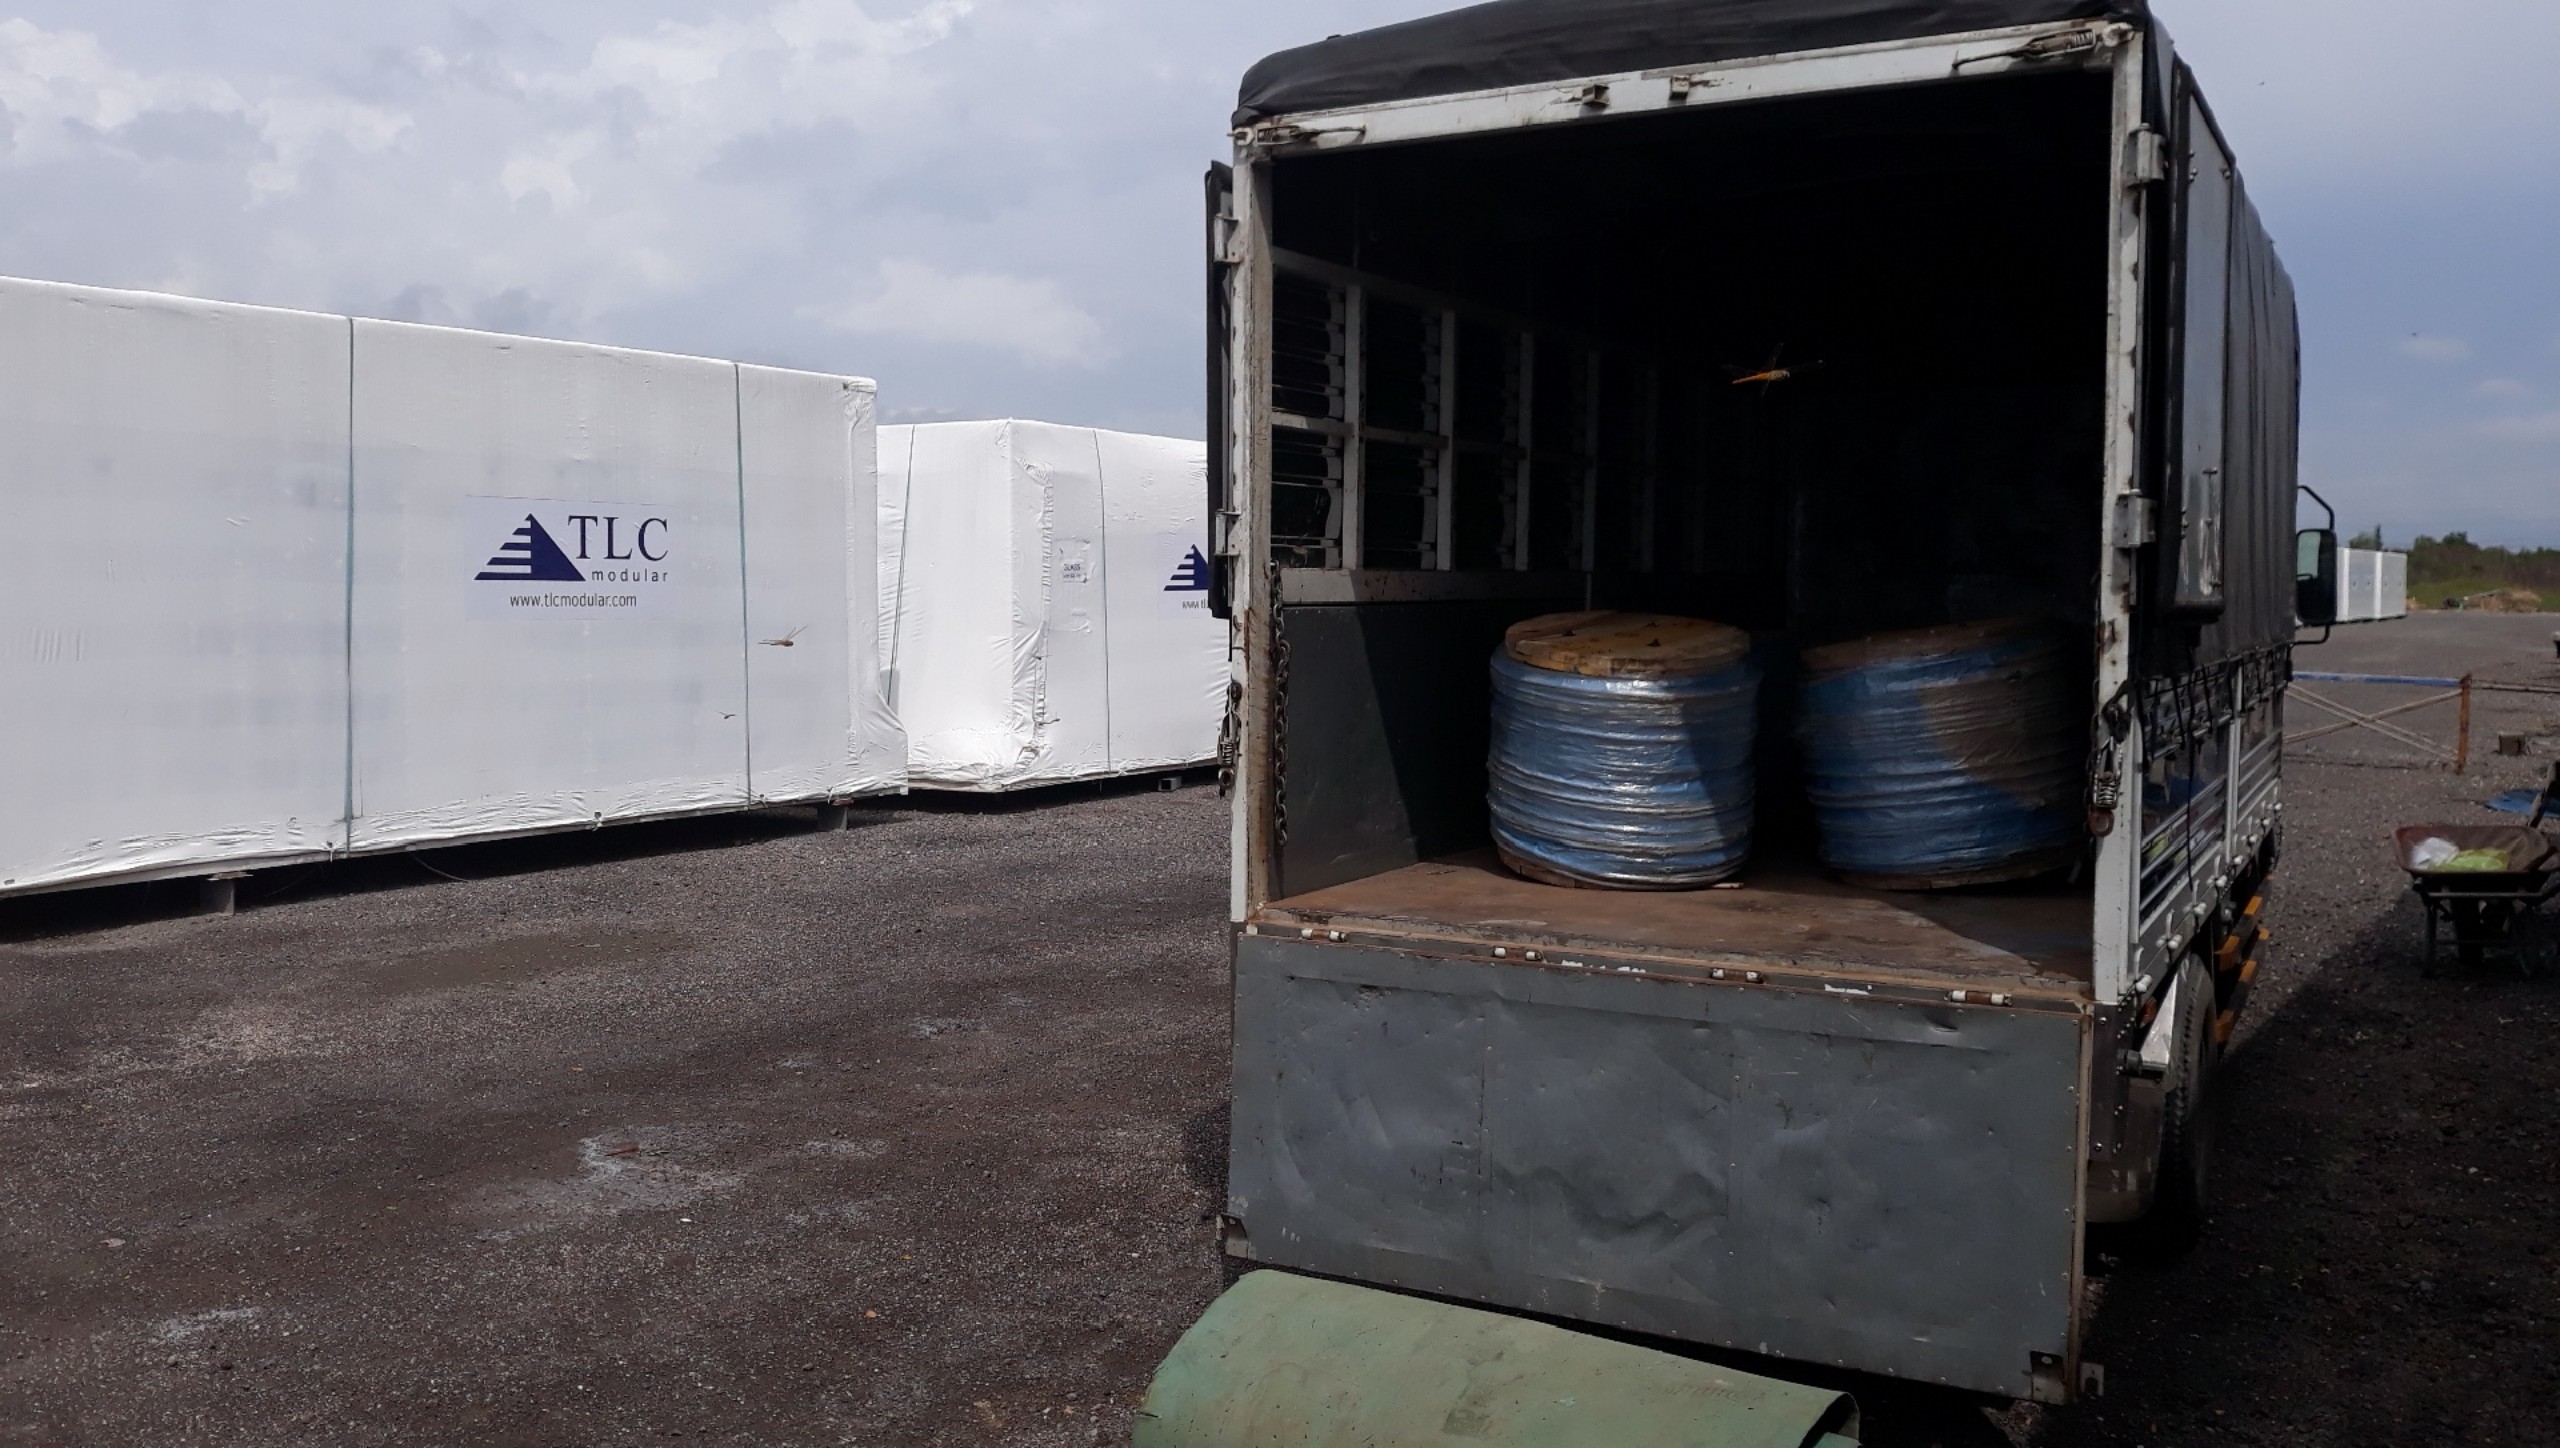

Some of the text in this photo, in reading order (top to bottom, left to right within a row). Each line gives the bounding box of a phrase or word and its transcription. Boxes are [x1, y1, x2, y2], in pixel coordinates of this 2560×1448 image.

[567, 515, 669, 562] TLC
[591, 568, 668, 582] modular
[509, 592, 637, 608] www.tlcmodular.com
